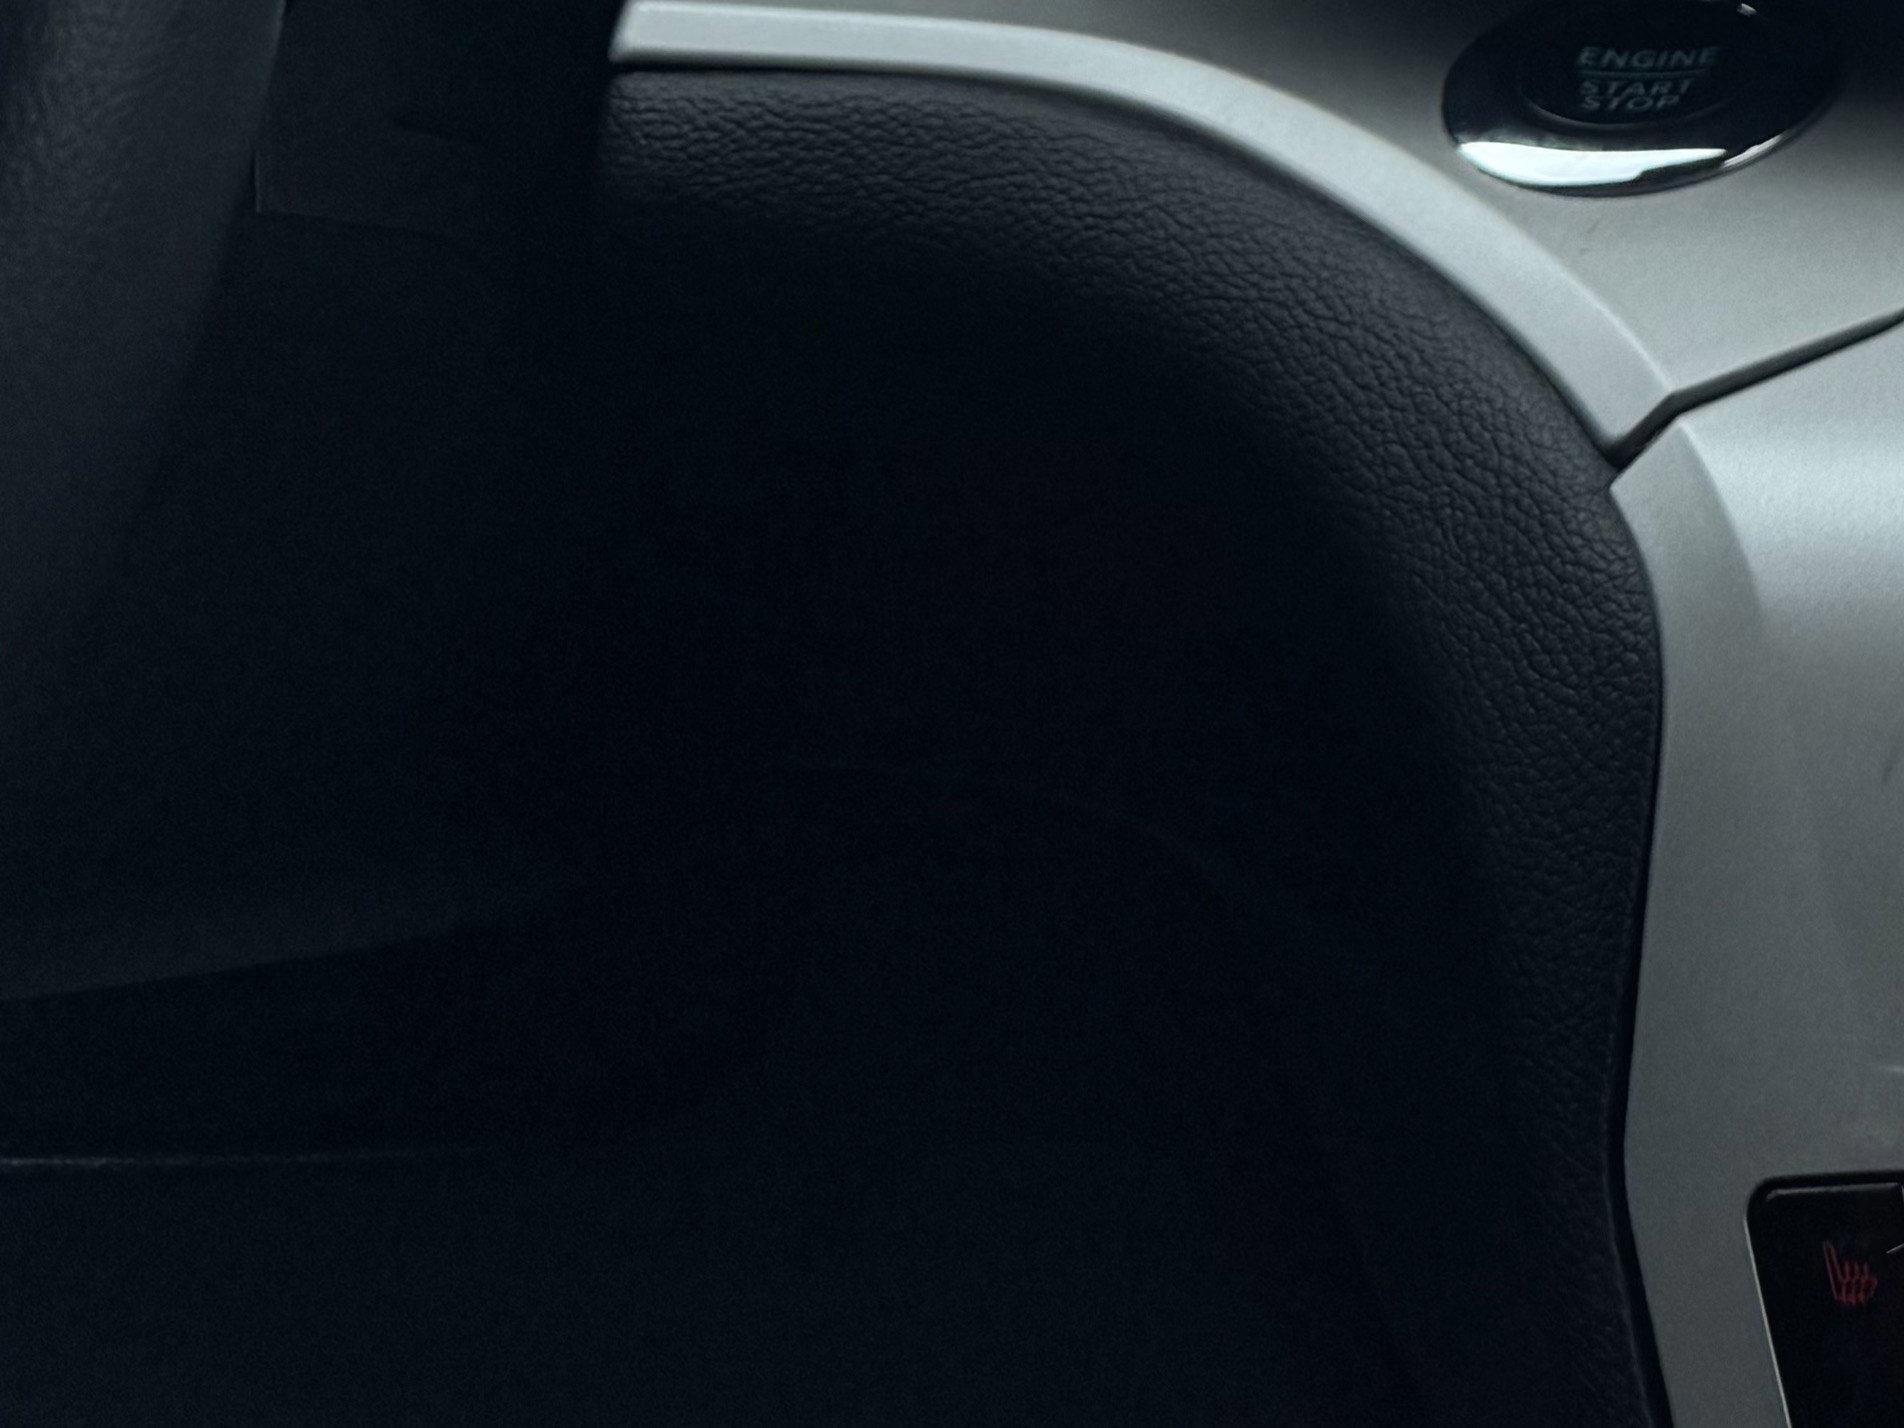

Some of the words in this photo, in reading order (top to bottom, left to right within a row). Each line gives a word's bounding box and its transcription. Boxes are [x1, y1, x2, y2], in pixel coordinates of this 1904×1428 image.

[1578, 46, 1719, 69] ENGINE
[1580, 77, 1695, 97] START
[1581, 94, 1682, 113] STOP
